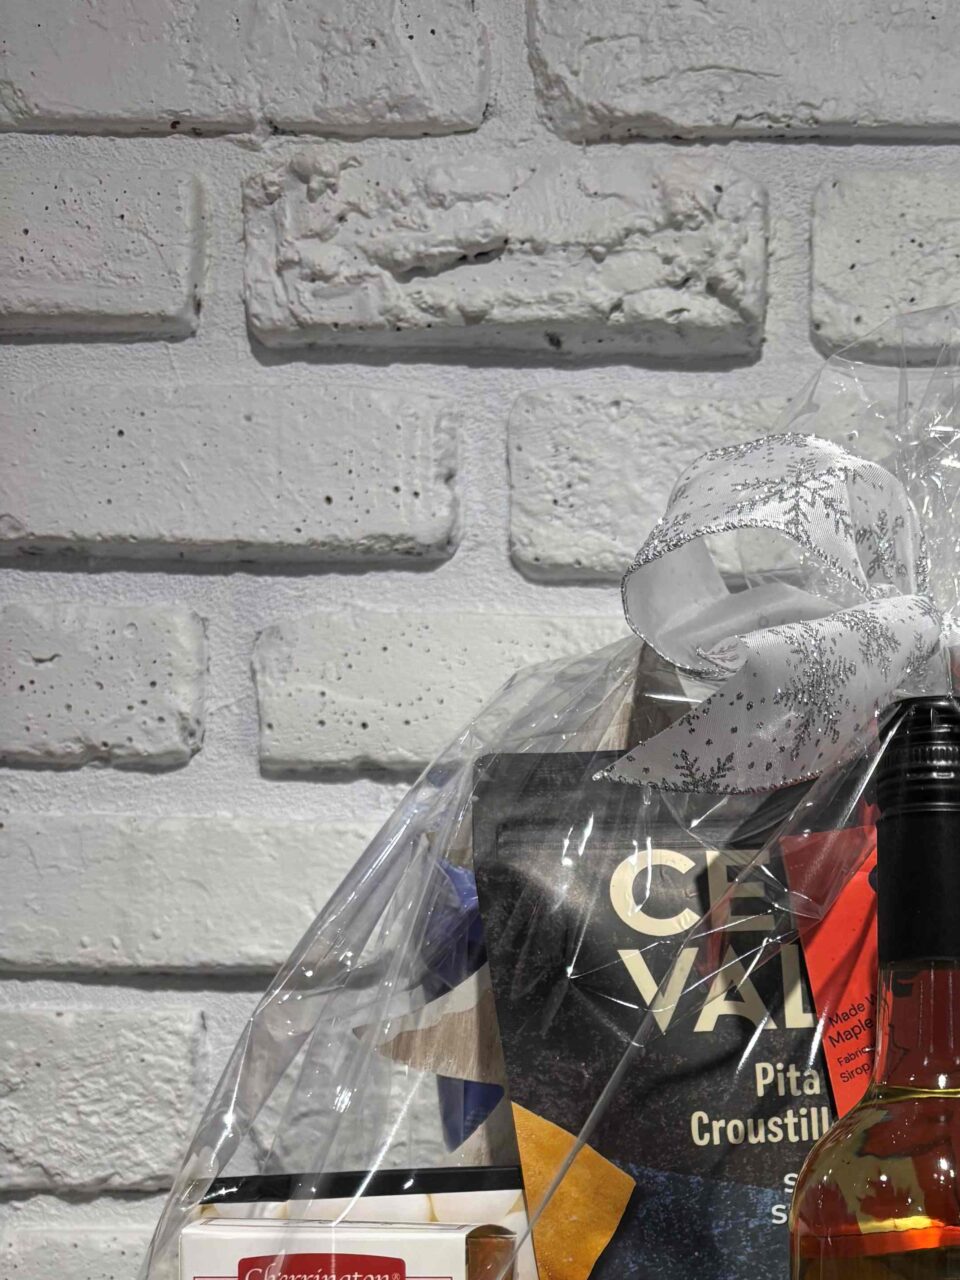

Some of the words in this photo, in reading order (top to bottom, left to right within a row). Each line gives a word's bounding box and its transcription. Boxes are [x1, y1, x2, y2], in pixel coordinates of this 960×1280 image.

[609, 848, 776, 937] CE
[616, 943, 817, 1034] VAL
[828, 1002, 865, 1028] Made
[828, 1017, 874, 1048] Maple
[755, 1062, 821, 1097] Pita
[840, 1061, 871, 1083] Sirop
[690, 1106, 829, 1147] Croustill
